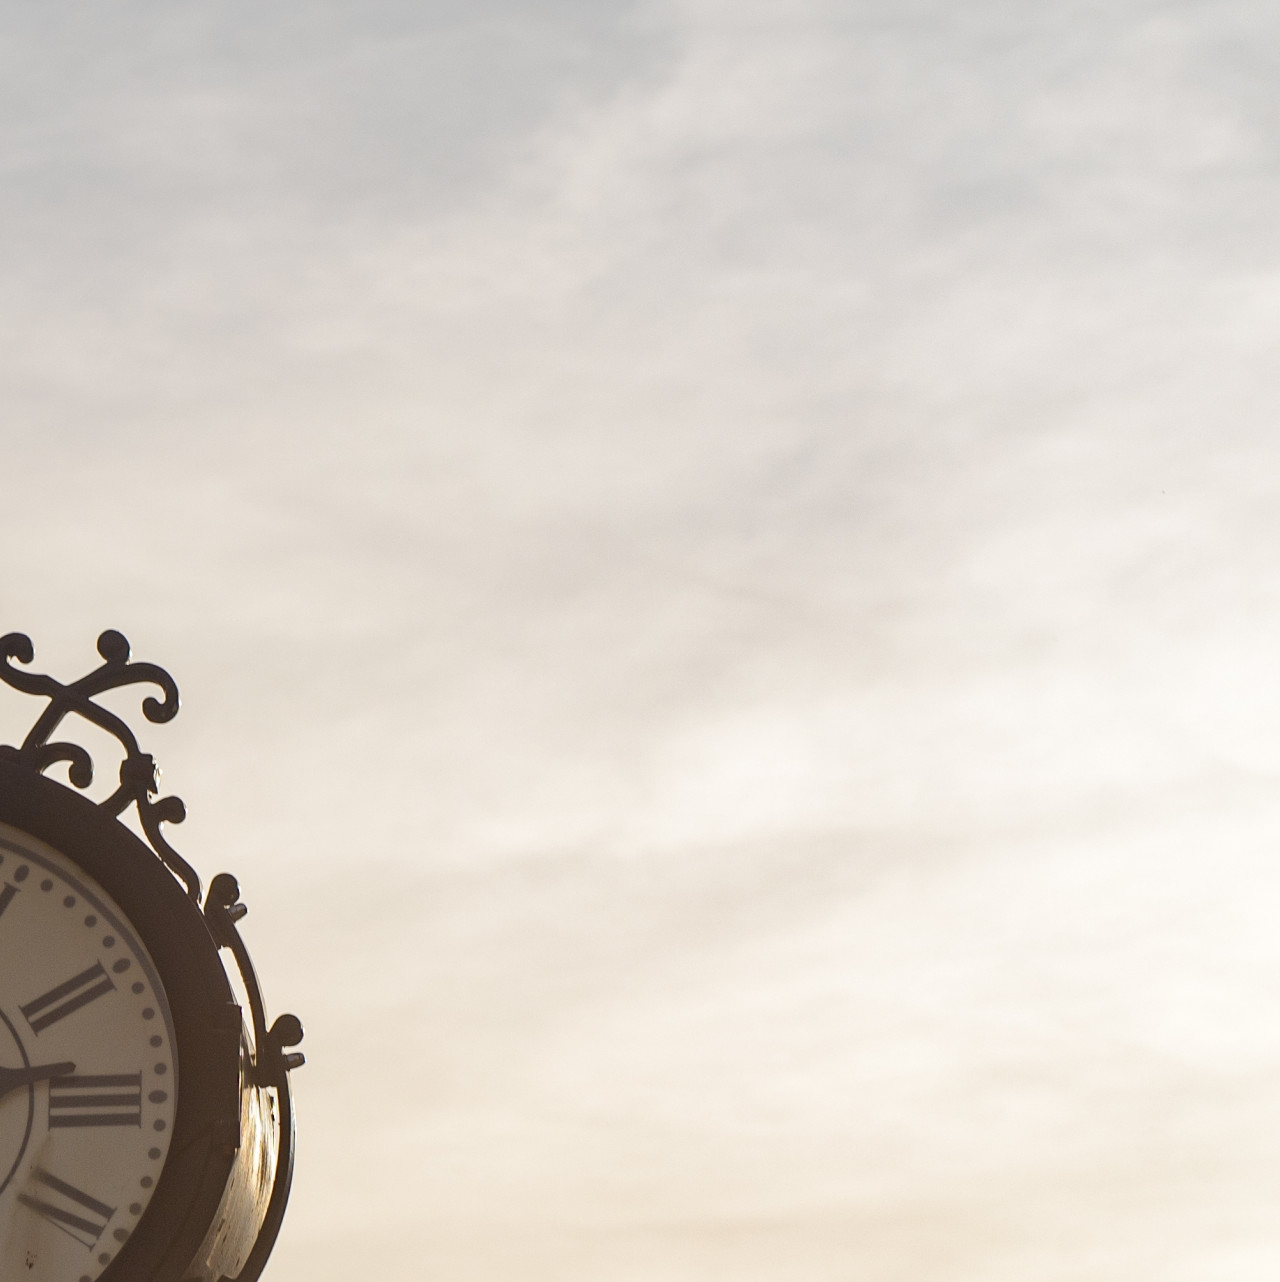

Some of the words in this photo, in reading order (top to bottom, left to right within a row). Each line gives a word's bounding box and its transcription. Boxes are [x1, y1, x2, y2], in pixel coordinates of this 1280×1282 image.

[18, 959, 117, 1037] II
[47, 1072, 143, 1129] III
[17, 1165, 118, 1252] IV
